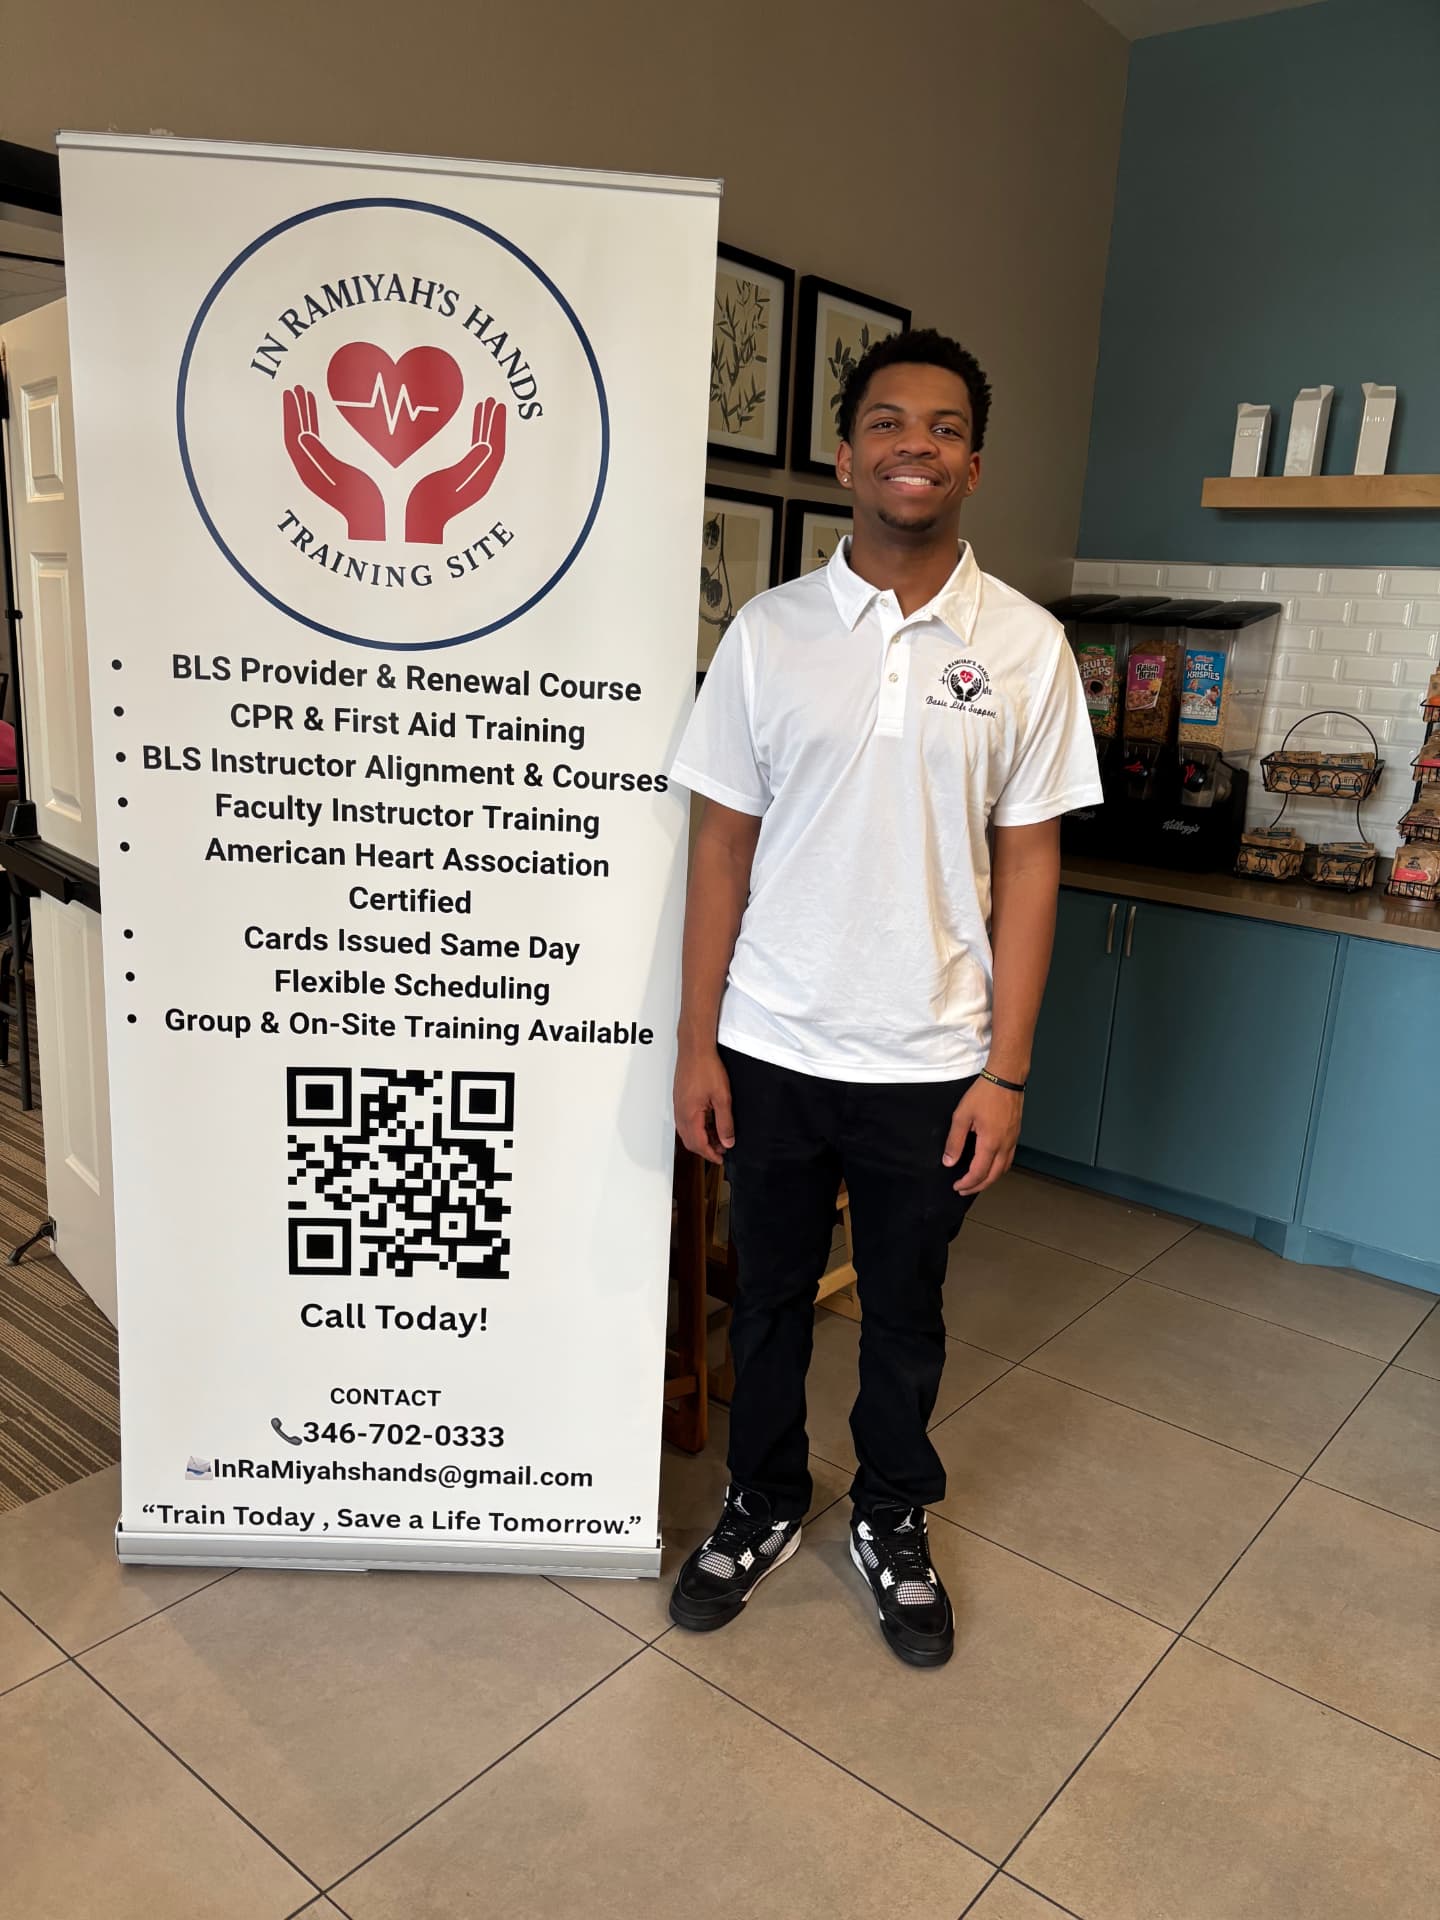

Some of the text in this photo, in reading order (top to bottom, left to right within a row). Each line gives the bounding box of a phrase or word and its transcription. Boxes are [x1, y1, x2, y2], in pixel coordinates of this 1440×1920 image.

[250, 333, 289, 379] IN
[462, 304, 544, 421] HANDS
[277, 509, 514, 588] TRAINING SITE
[172, 653, 642, 702] BLS Provider & Renewal Course
[1136, 663, 1159, 674] Raisin
[1187, 671, 1220, 680] KRISPIES
[1195, 663, 1213, 671] RICE
[926, 696, 998, 718] Basic Life Support
[230, 703, 585, 751] CPR & First Aid Training
[142, 745, 669, 793] BLS Instructor Alignment & Courses
[215, 793, 600, 840] Faculty Instructor Training
[204, 837, 609, 878] American Heart Association
[349, 886, 472, 914] Certified
[244, 925, 581, 966] Cards Issued Same Day
[275, 968, 550, 1006] Flexible Scheduling
[165, 1008, 654, 1047] Group & On-Site Training Available
[300, 1302, 487, 1339] Call Today!
[330, 1387, 442, 1407] CONTACT
[303, 1421, 504, 1448] 346-702-0333
[214, 1458, 593, 1489] InRaMiyahshands@gmail.com
[232, 1506, 316, 1532] Today
[337, 1508, 401, 1529] Save
[408, 1514, 424, 1530] a
[432, 1510, 481, 1531] Life
